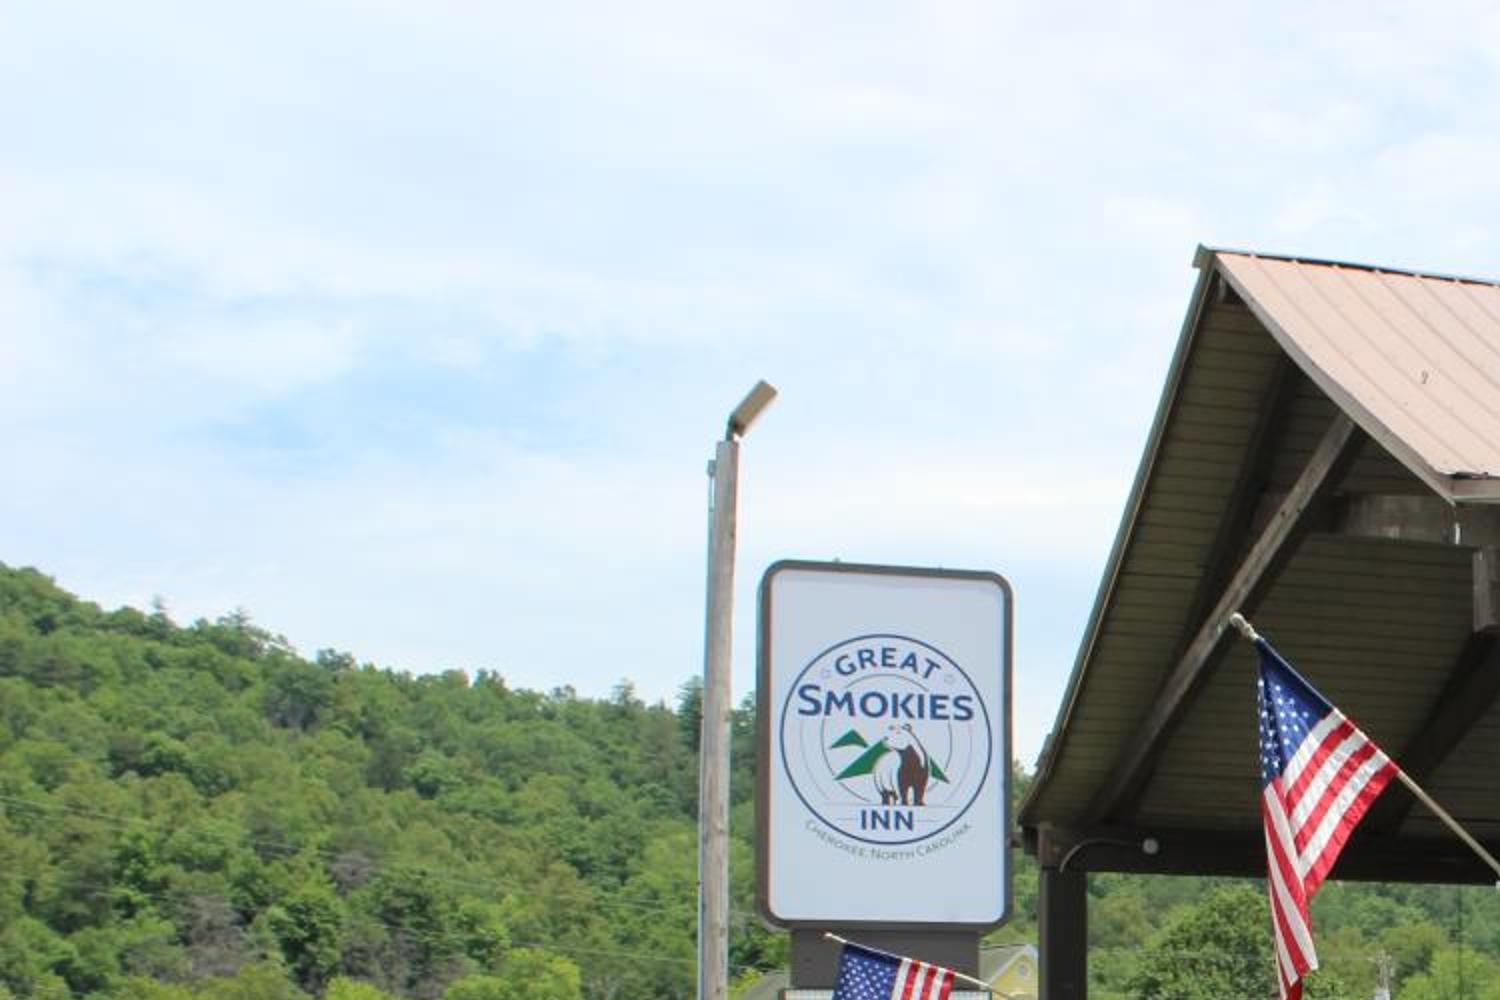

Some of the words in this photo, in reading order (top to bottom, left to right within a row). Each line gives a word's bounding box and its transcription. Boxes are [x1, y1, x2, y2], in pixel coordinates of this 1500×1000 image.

[835, 647, 941, 681] GREAT
[797, 684, 975, 722] SMOKIES
[859, 809, 914, 831] INN
[871, 848, 915, 861] NORTH
[916, 823, 972, 856] CAROLINA
